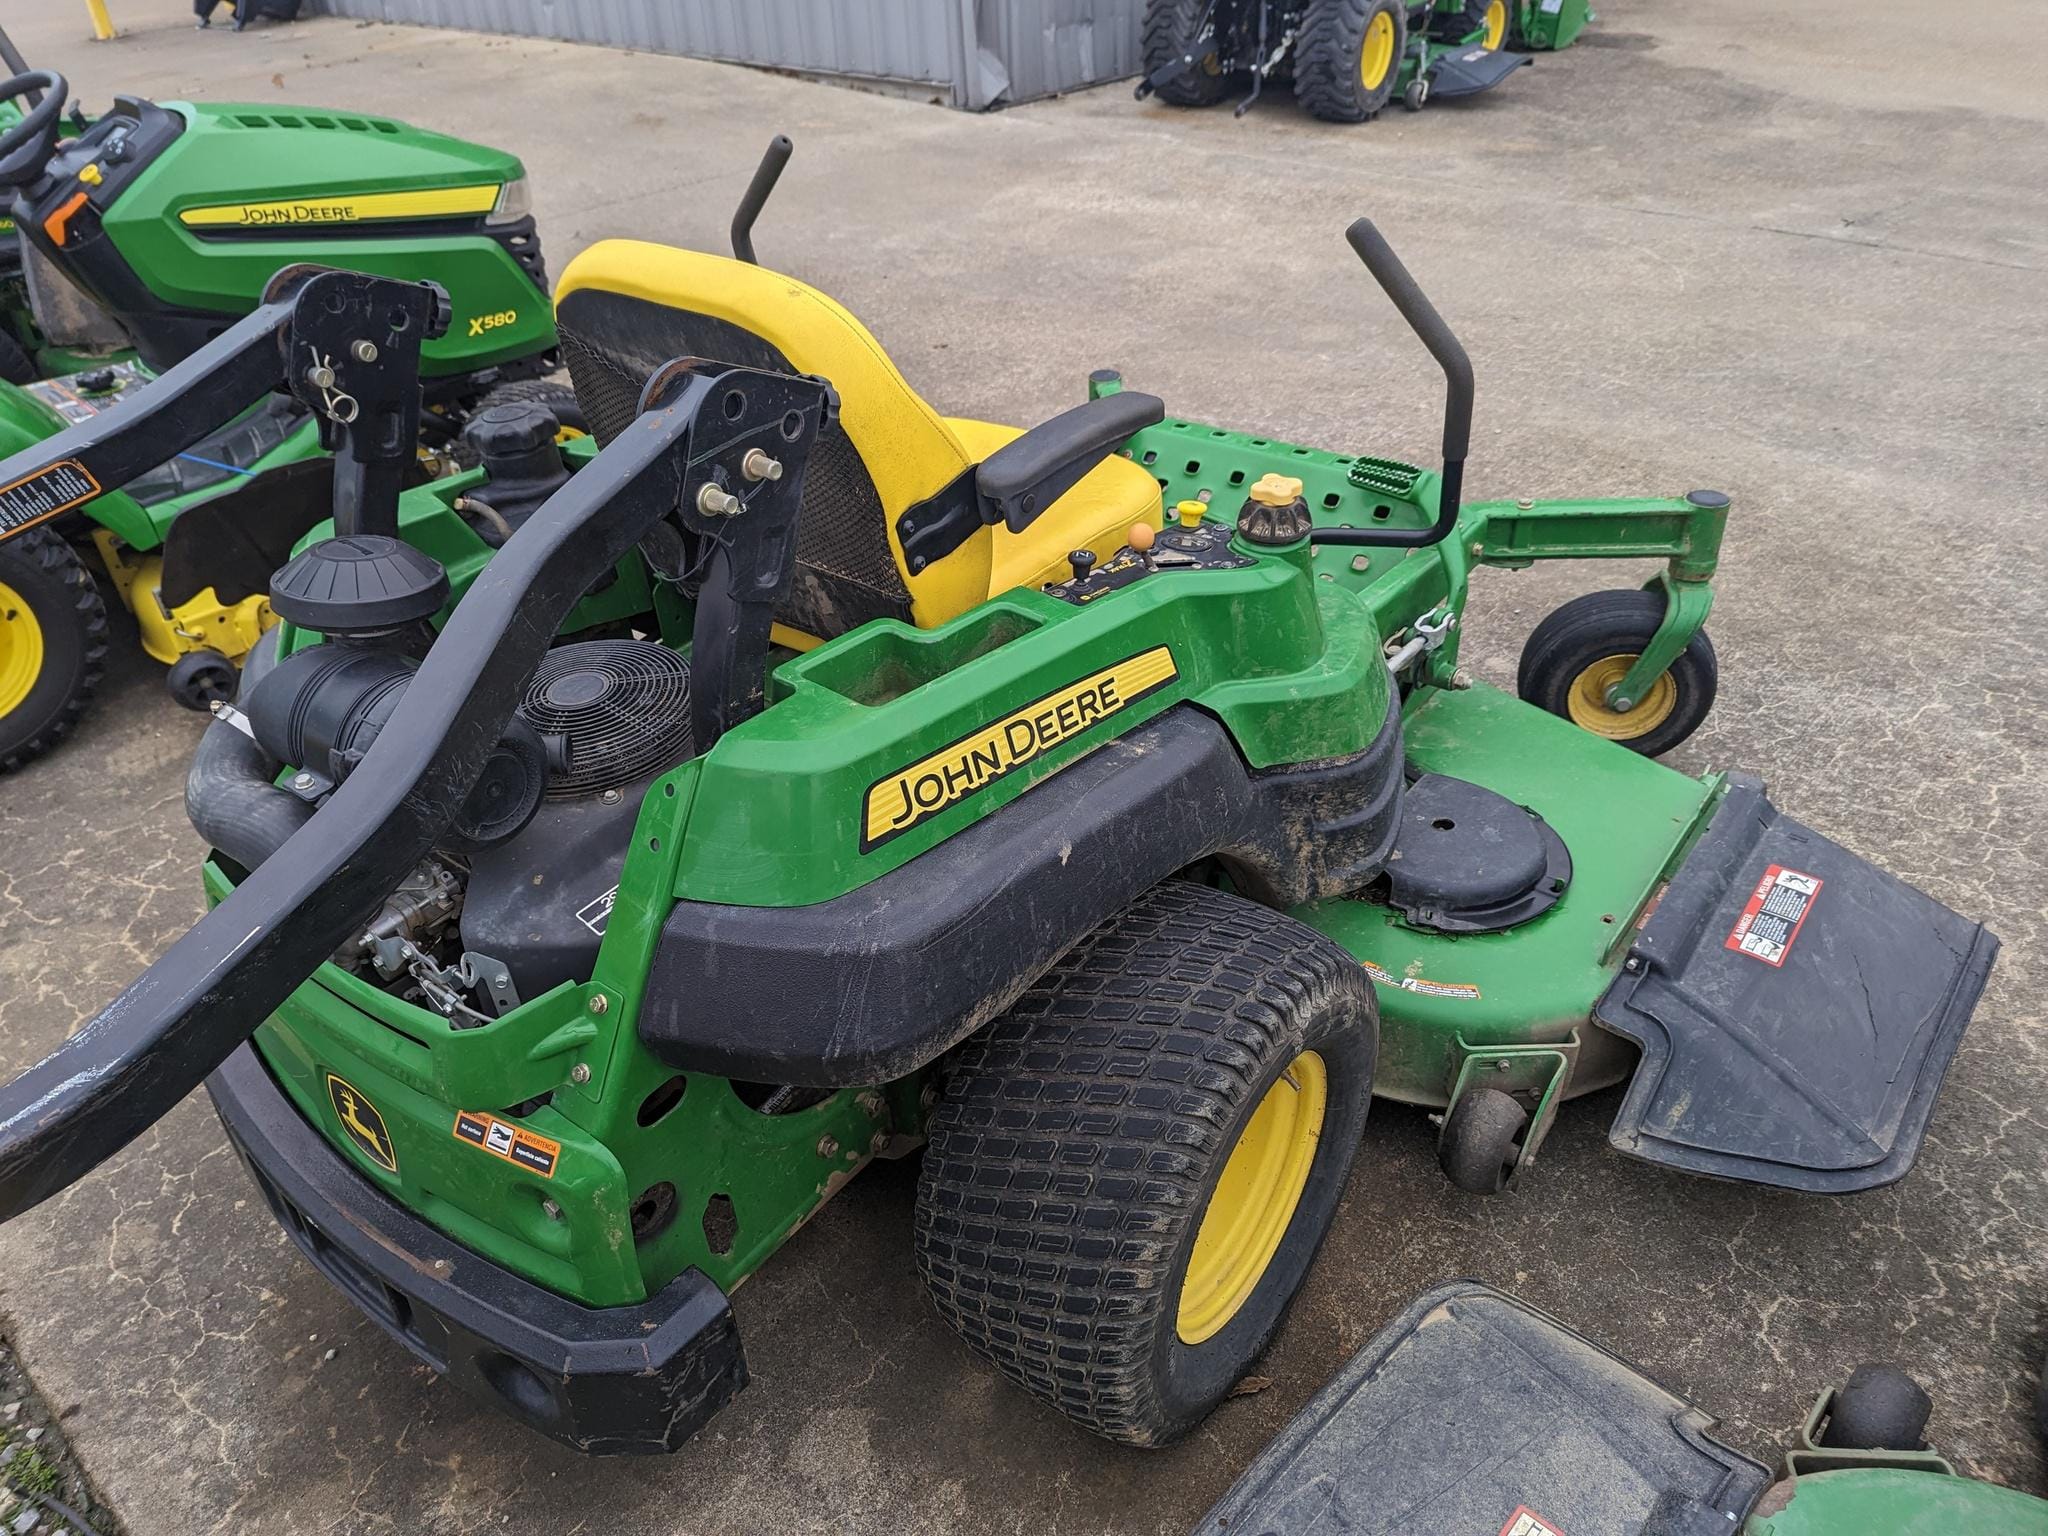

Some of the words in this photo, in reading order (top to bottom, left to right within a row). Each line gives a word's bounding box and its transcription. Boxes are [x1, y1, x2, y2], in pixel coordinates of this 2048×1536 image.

[240, 206, 290, 223] JOHN
[294, 206, 356, 220] DEERE
[468, 310, 517, 337] X580
[891, 740, 1002, 825] JOHN
[1005, 677, 1121, 762] DEERE
[1735, 913, 1755, 937] DANGER
[524, 1134, 556, 1153] ADVERTENCIA
